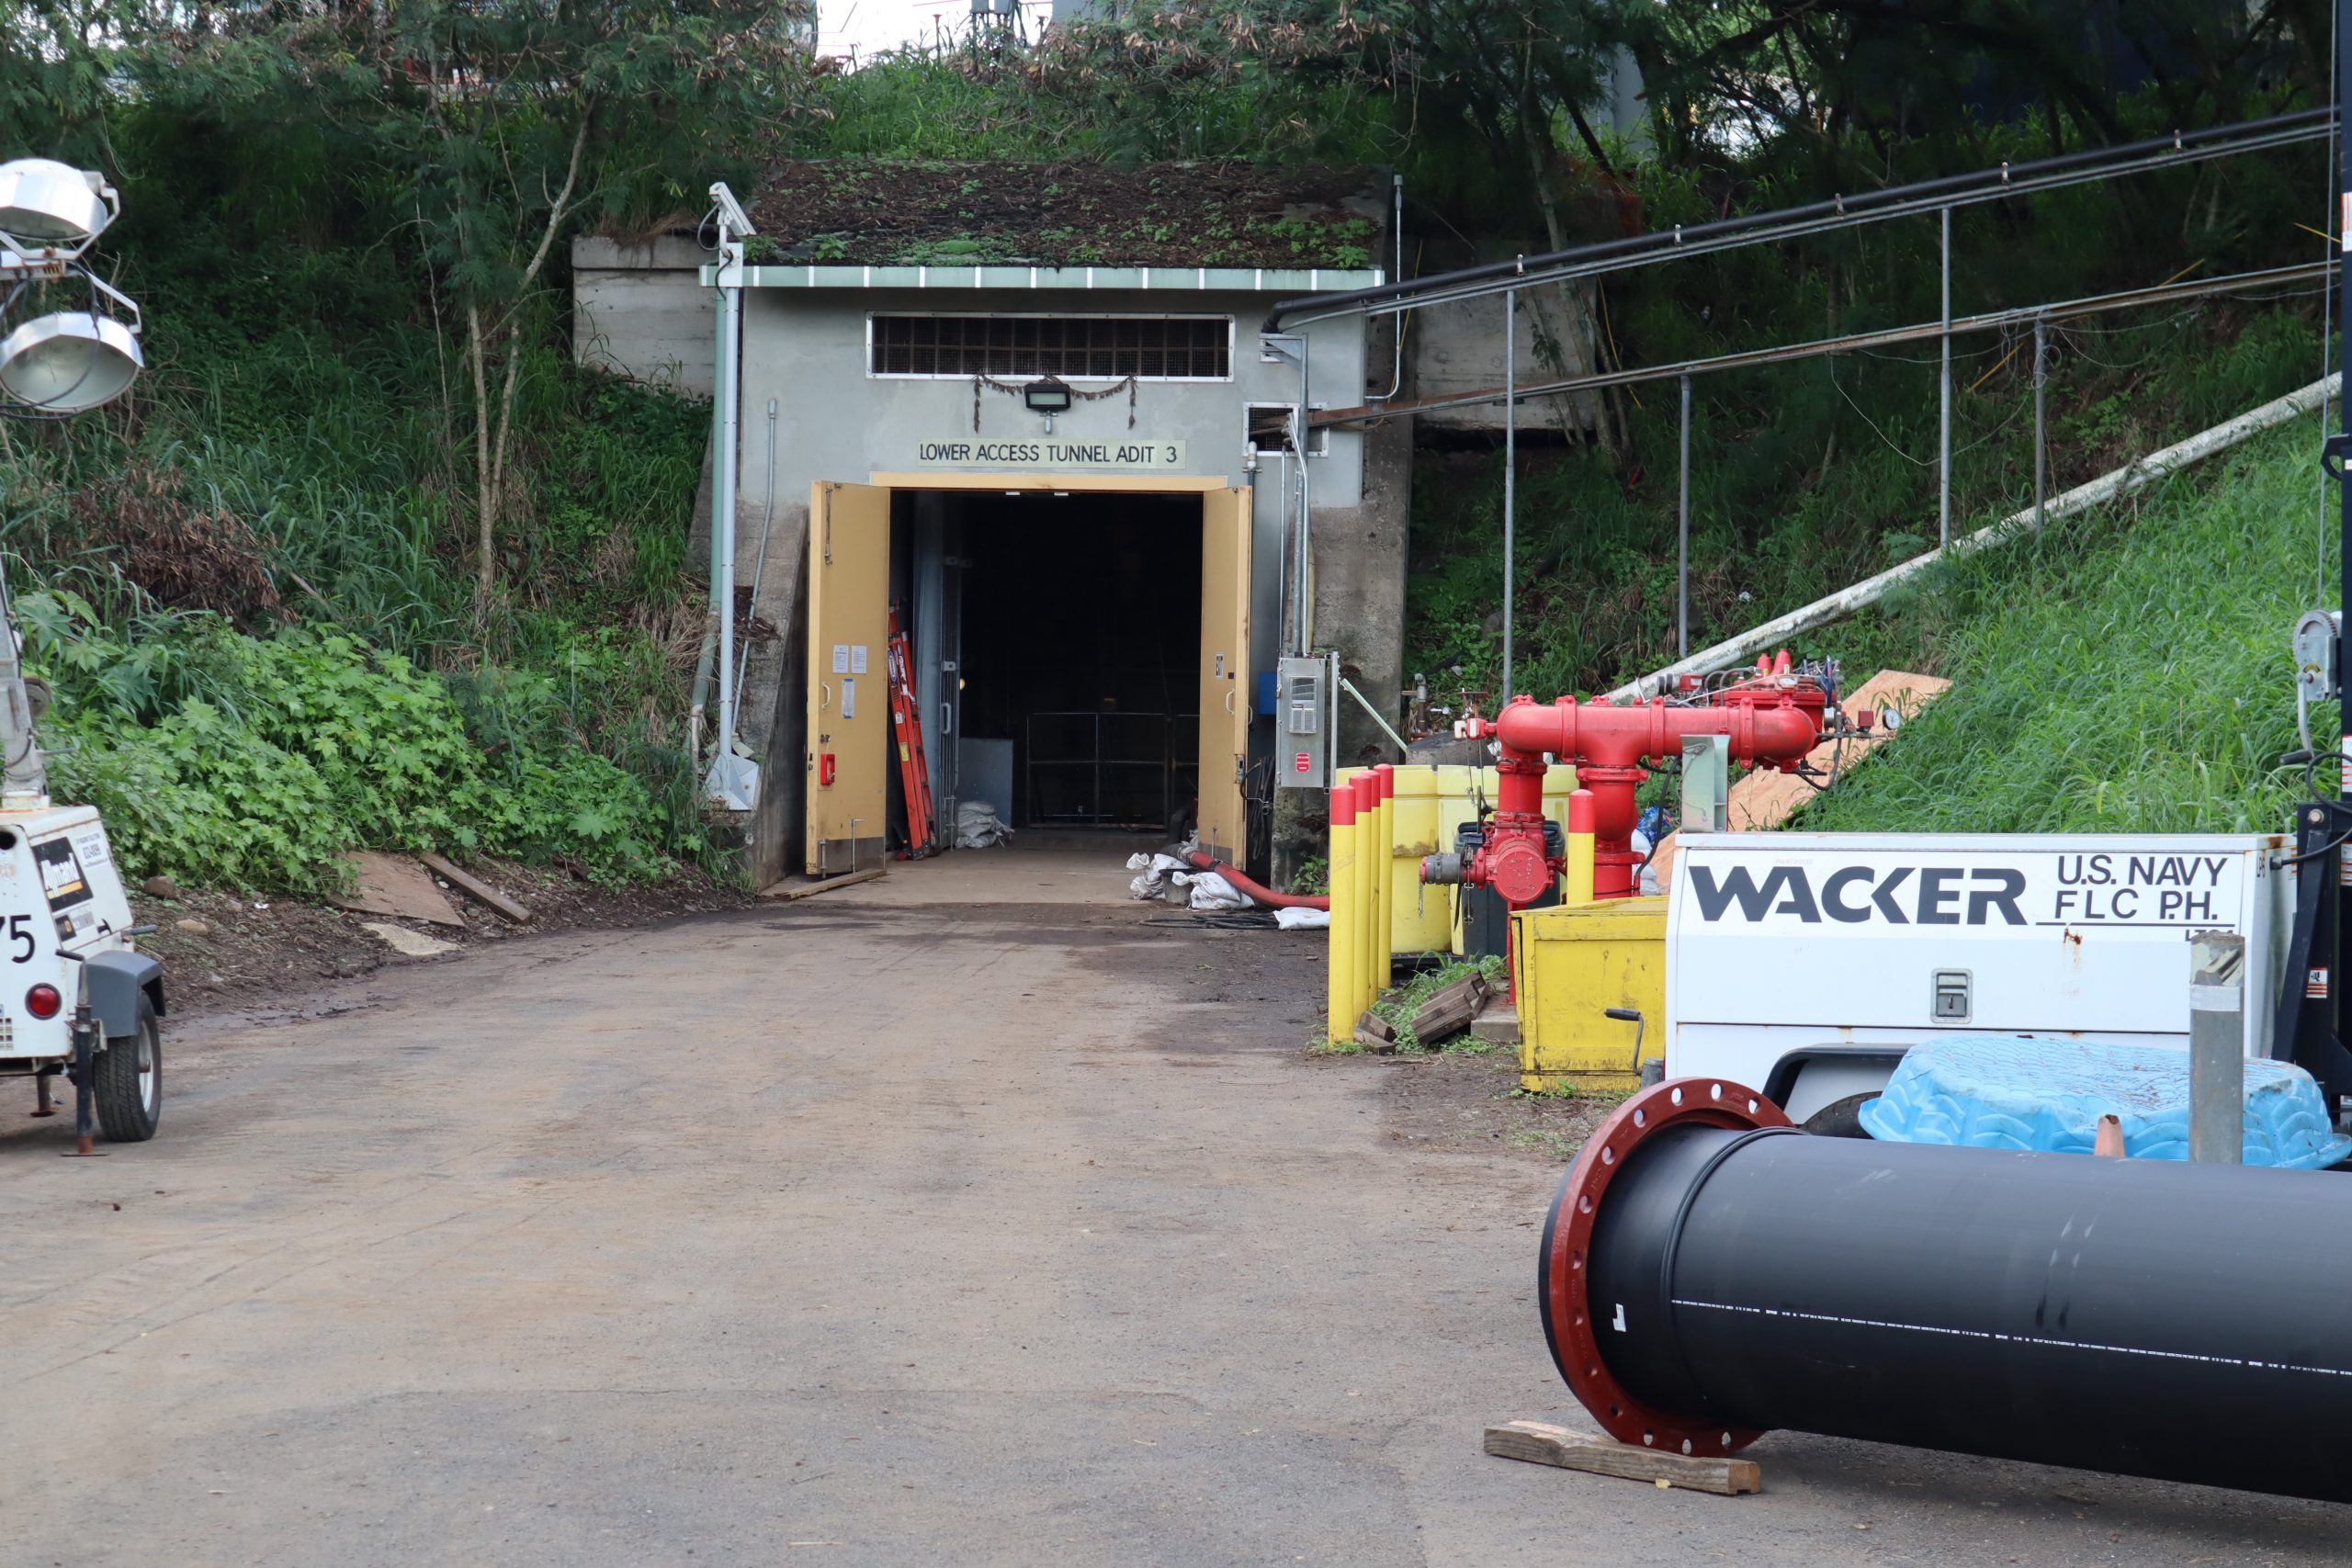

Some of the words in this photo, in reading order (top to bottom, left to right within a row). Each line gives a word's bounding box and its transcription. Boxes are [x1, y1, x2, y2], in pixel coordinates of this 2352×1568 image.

[920, 444, 970, 461] LOWER
[976, 444, 1040, 462] ACCESS
[1046, 445, 1111, 463] TUNNEL
[1115, 446, 1155, 463] ADIT
[1166, 446, 1177, 463] 3
[2058, 854, 2117, 885] U.S.
[2128, 856, 2228, 886] NAVY
[1689, 865, 2029, 926] WACKER
[2159, 890, 2218, 920] P.H.
[0, 914, 35, 964] 5
